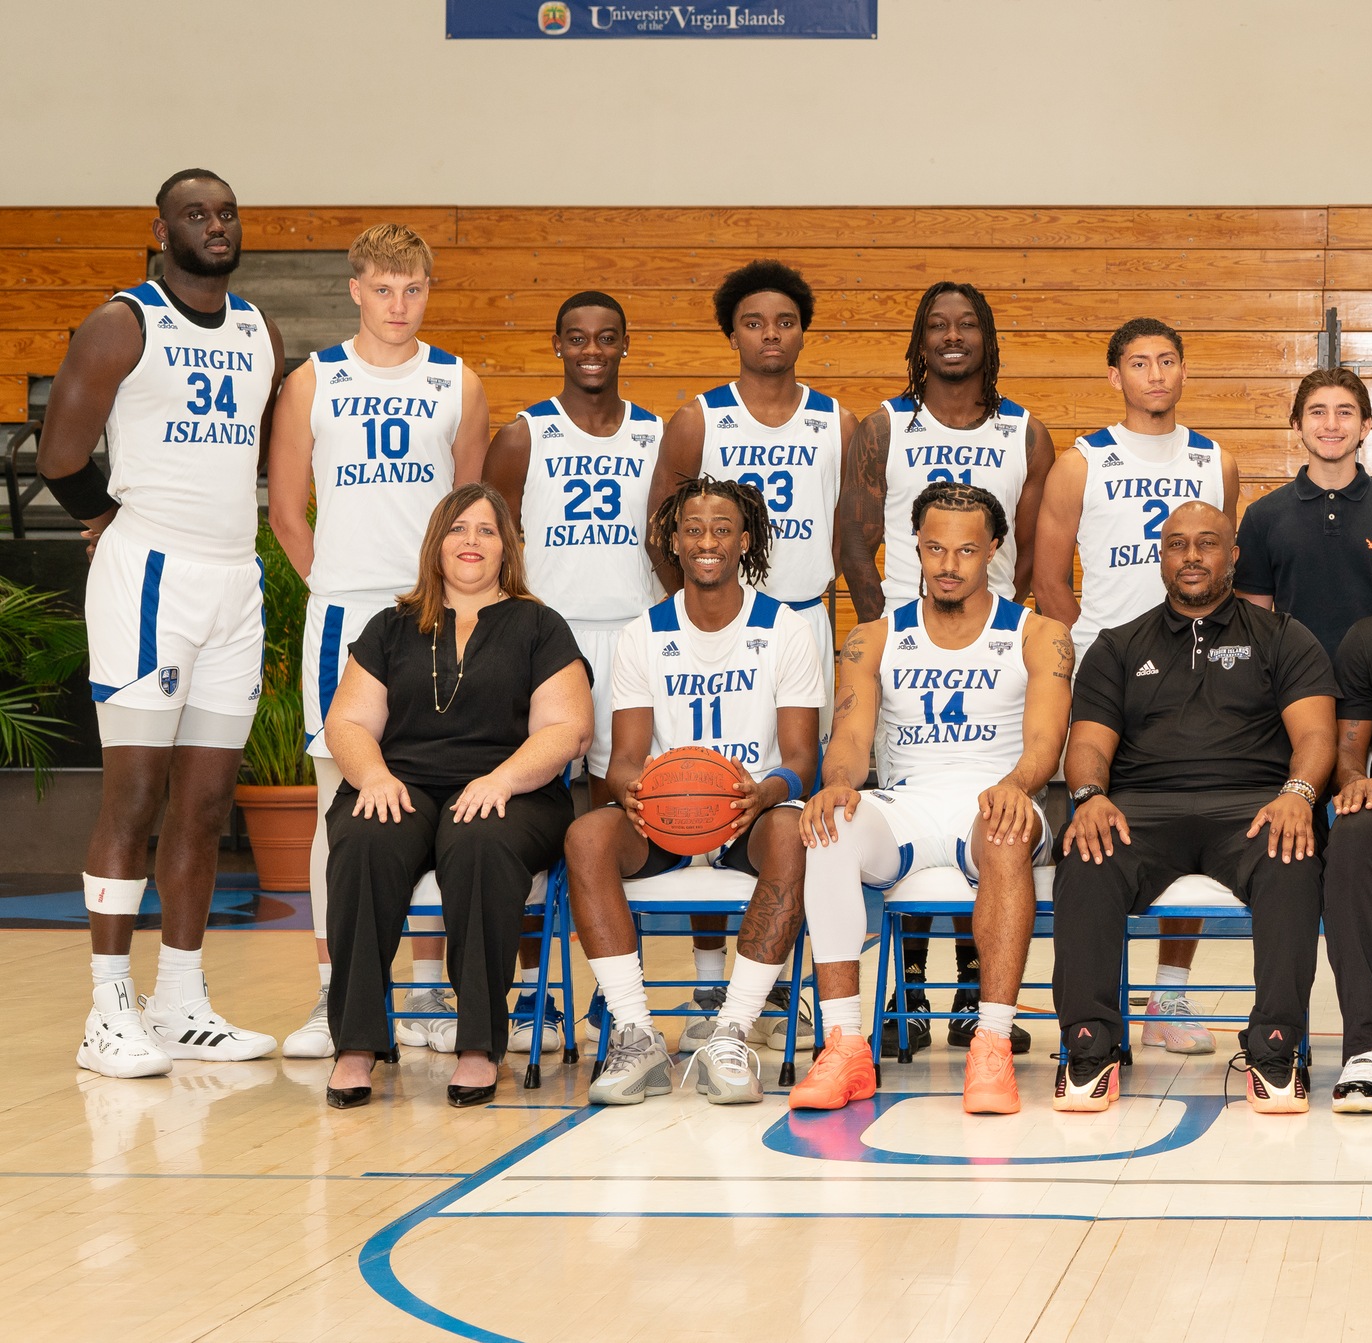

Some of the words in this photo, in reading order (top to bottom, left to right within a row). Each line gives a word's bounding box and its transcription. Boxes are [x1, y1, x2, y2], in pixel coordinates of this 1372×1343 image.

[588, 6, 673, 30] University
[637, 22, 648, 30] of
[648, 22, 664, 31] the
[669, 6, 728, 30] Virgin
[728, 5, 786, 30] Islands
[163, 346, 254, 372] VIRGIN
[330, 376, 352, 385] adidas
[186, 372, 237, 419] 34
[331, 396, 438, 419] VIRGIN
[162, 421, 256, 446] ISLANDS
[362, 417, 410, 459] 10
[544, 455, 645, 478] VIRGIN
[719, 445, 818, 467] VIRGIN
[905, 445, 1006, 469] VIRGIN
[1102, 460, 1124, 468] adidas
[335, 462, 435, 487] ISLANDS
[563, 479, 621, 521] 23
[1104, 477, 1203, 500] VIRGIN
[1142, 499, 1170, 540] 2
[544, 524, 639, 547] ISLANDS
[1109, 543, 1161, 568] ISLA
[664, 668, 757, 696] VIRGIN
[893, 669, 1001, 690] VIRGIN
[1136, 668, 1159, 677] adidas
[688, 696, 722, 741] 11
[920, 691, 968, 725] 14
[896, 724, 997, 746] ISLANDS
[651, 771, 726, 791] SPALDING
